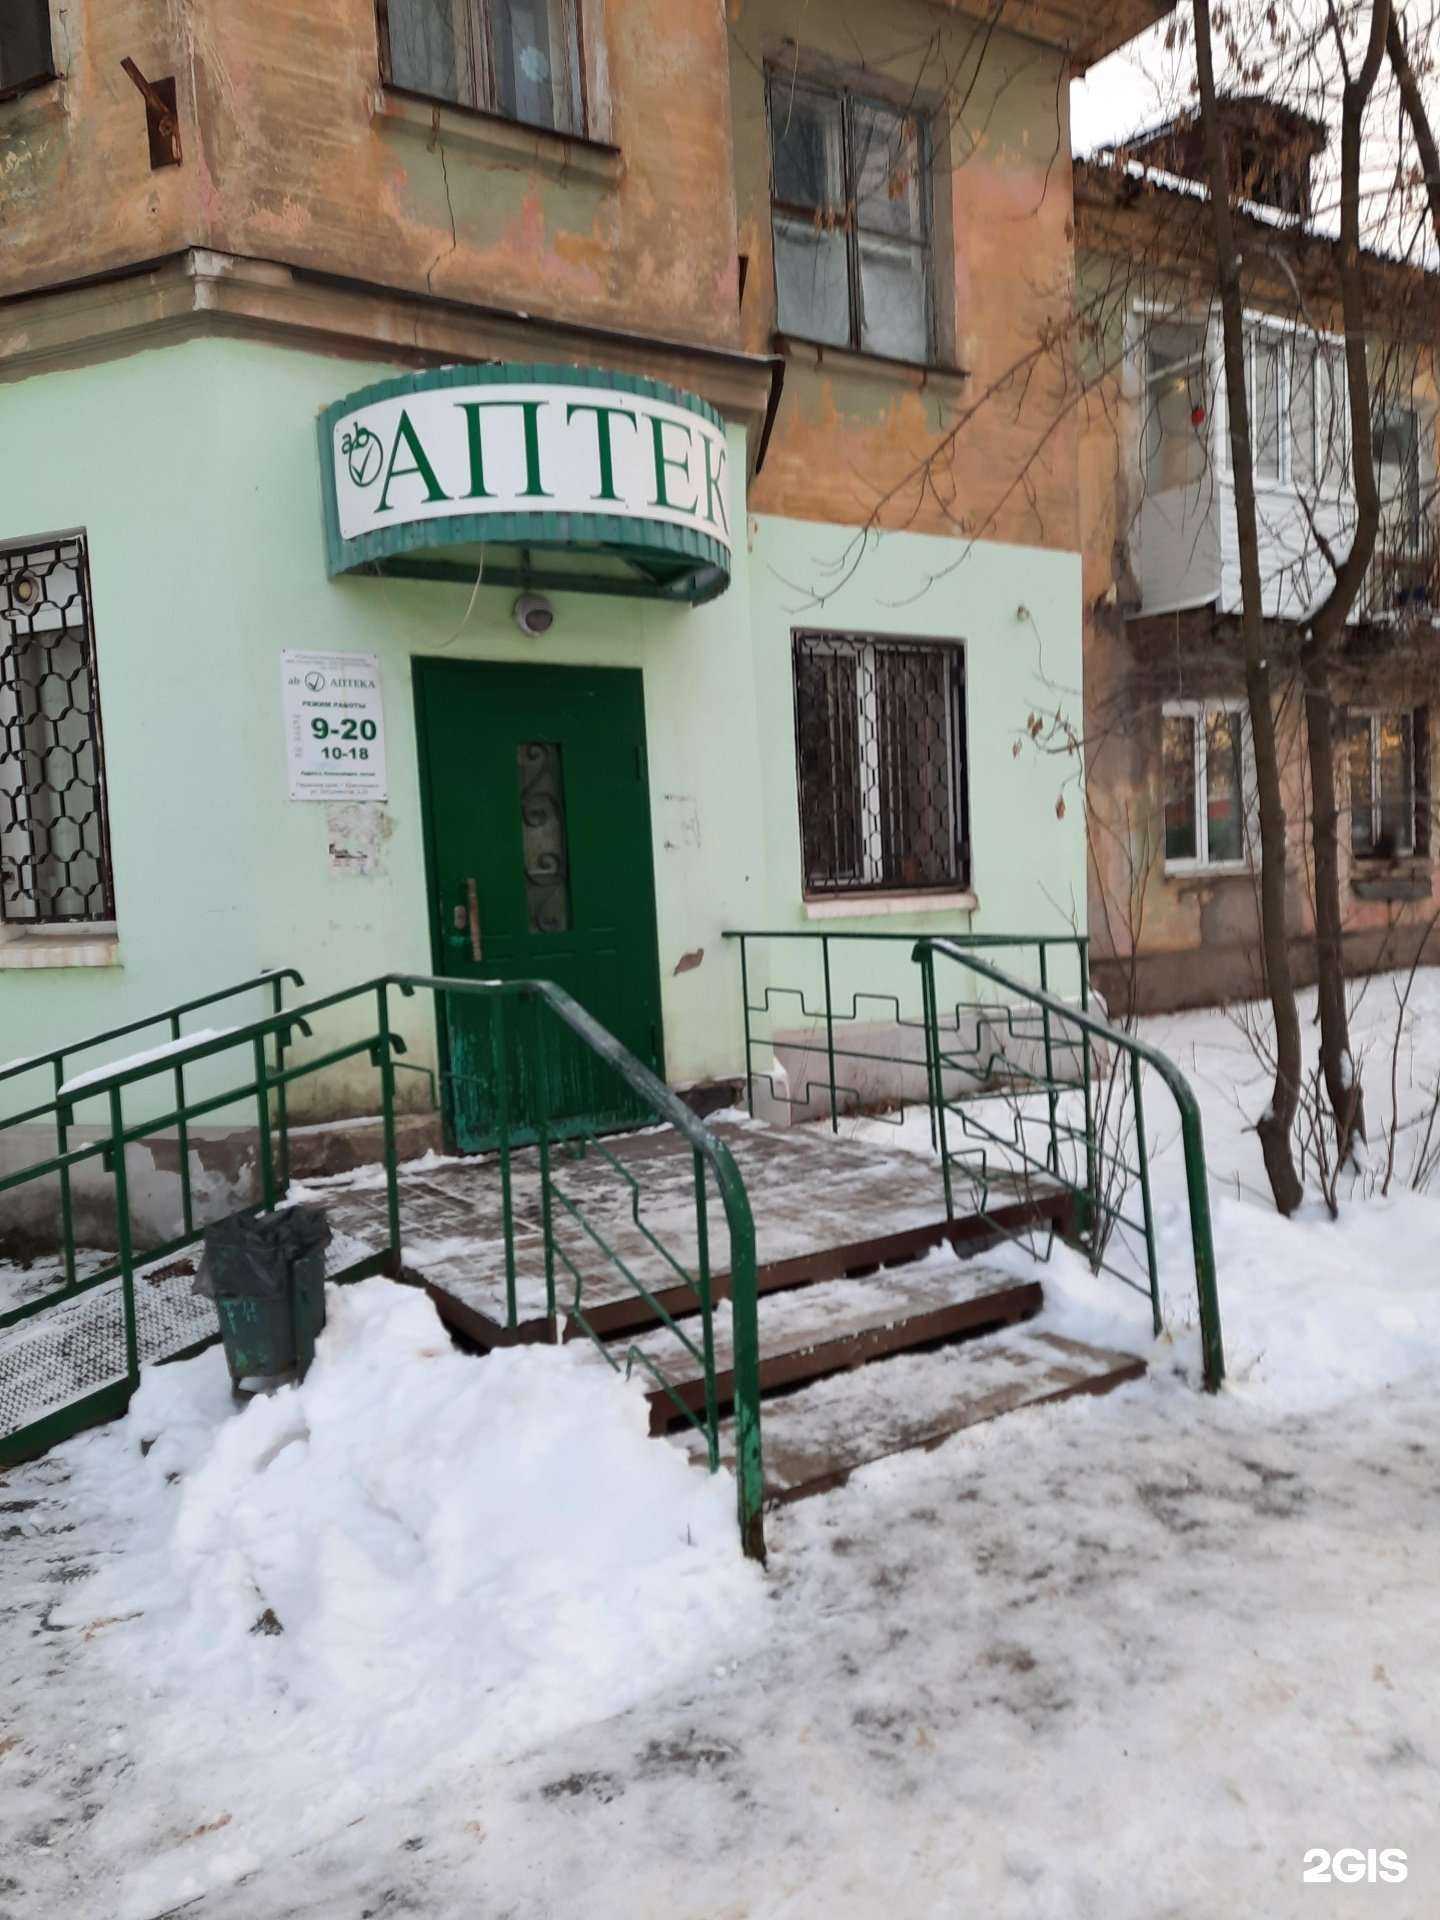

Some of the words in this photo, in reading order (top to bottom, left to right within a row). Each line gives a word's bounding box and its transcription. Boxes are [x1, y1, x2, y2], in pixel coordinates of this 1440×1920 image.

[330, 678, 376, 689] АПТЕКА
[310, 717, 377, 741] 9-20
[321, 747, 369, 760] 10-18
